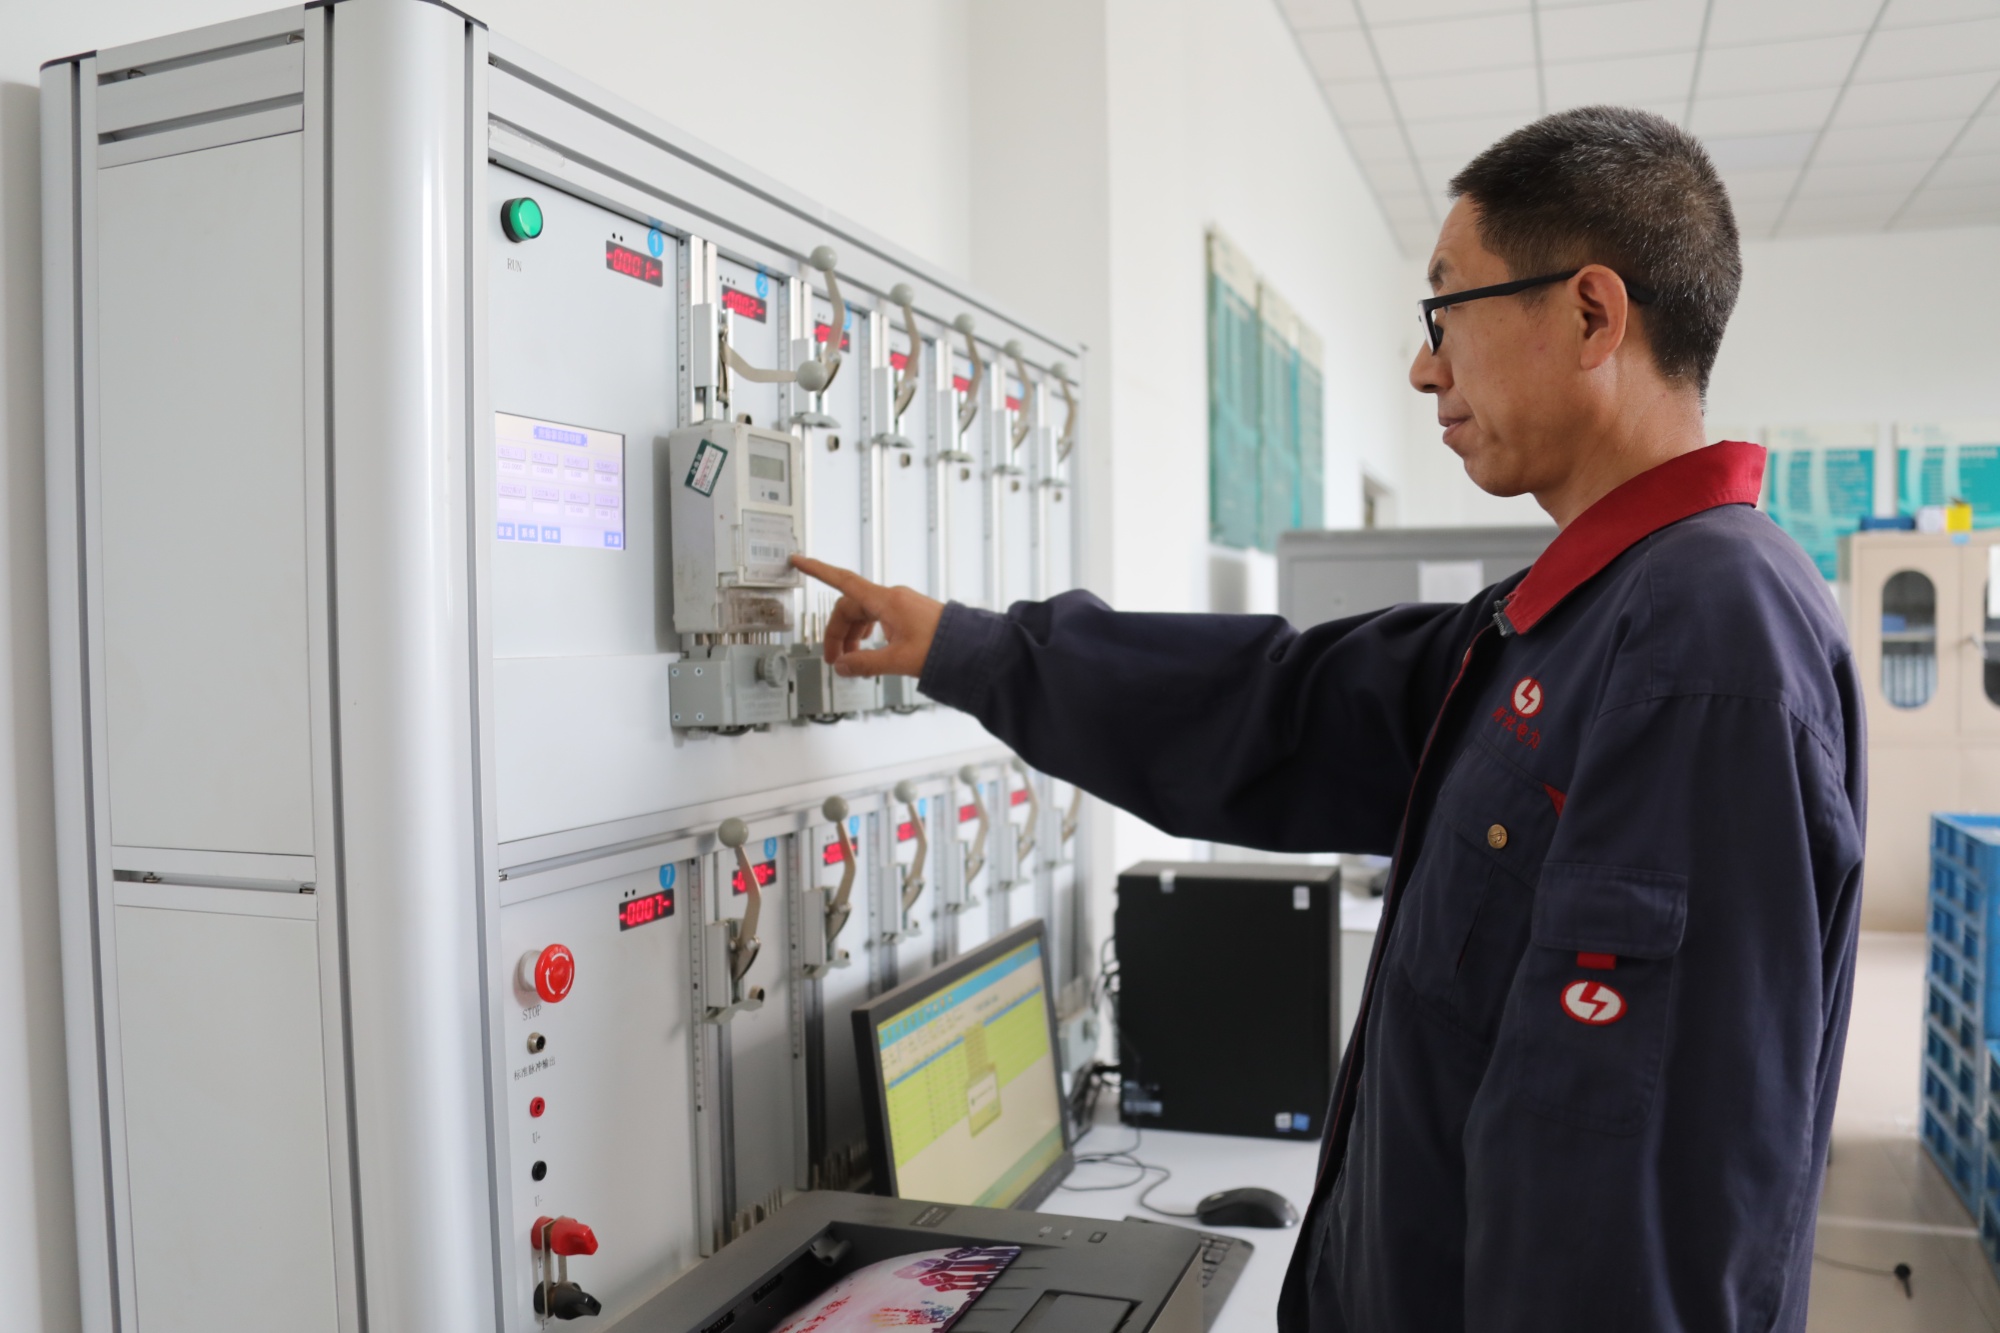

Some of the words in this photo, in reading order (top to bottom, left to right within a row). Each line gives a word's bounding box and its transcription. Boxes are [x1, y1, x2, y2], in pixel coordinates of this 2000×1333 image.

[651, 231, 659, 252] 1
[507, 257, 522, 273] RUN
[758, 276, 767, 294] 2
[663, 865, 672, 885] 7
[522, 1004, 542, 1021] STOP
[514, 1056, 556, 1081] 标准脉冲输出
